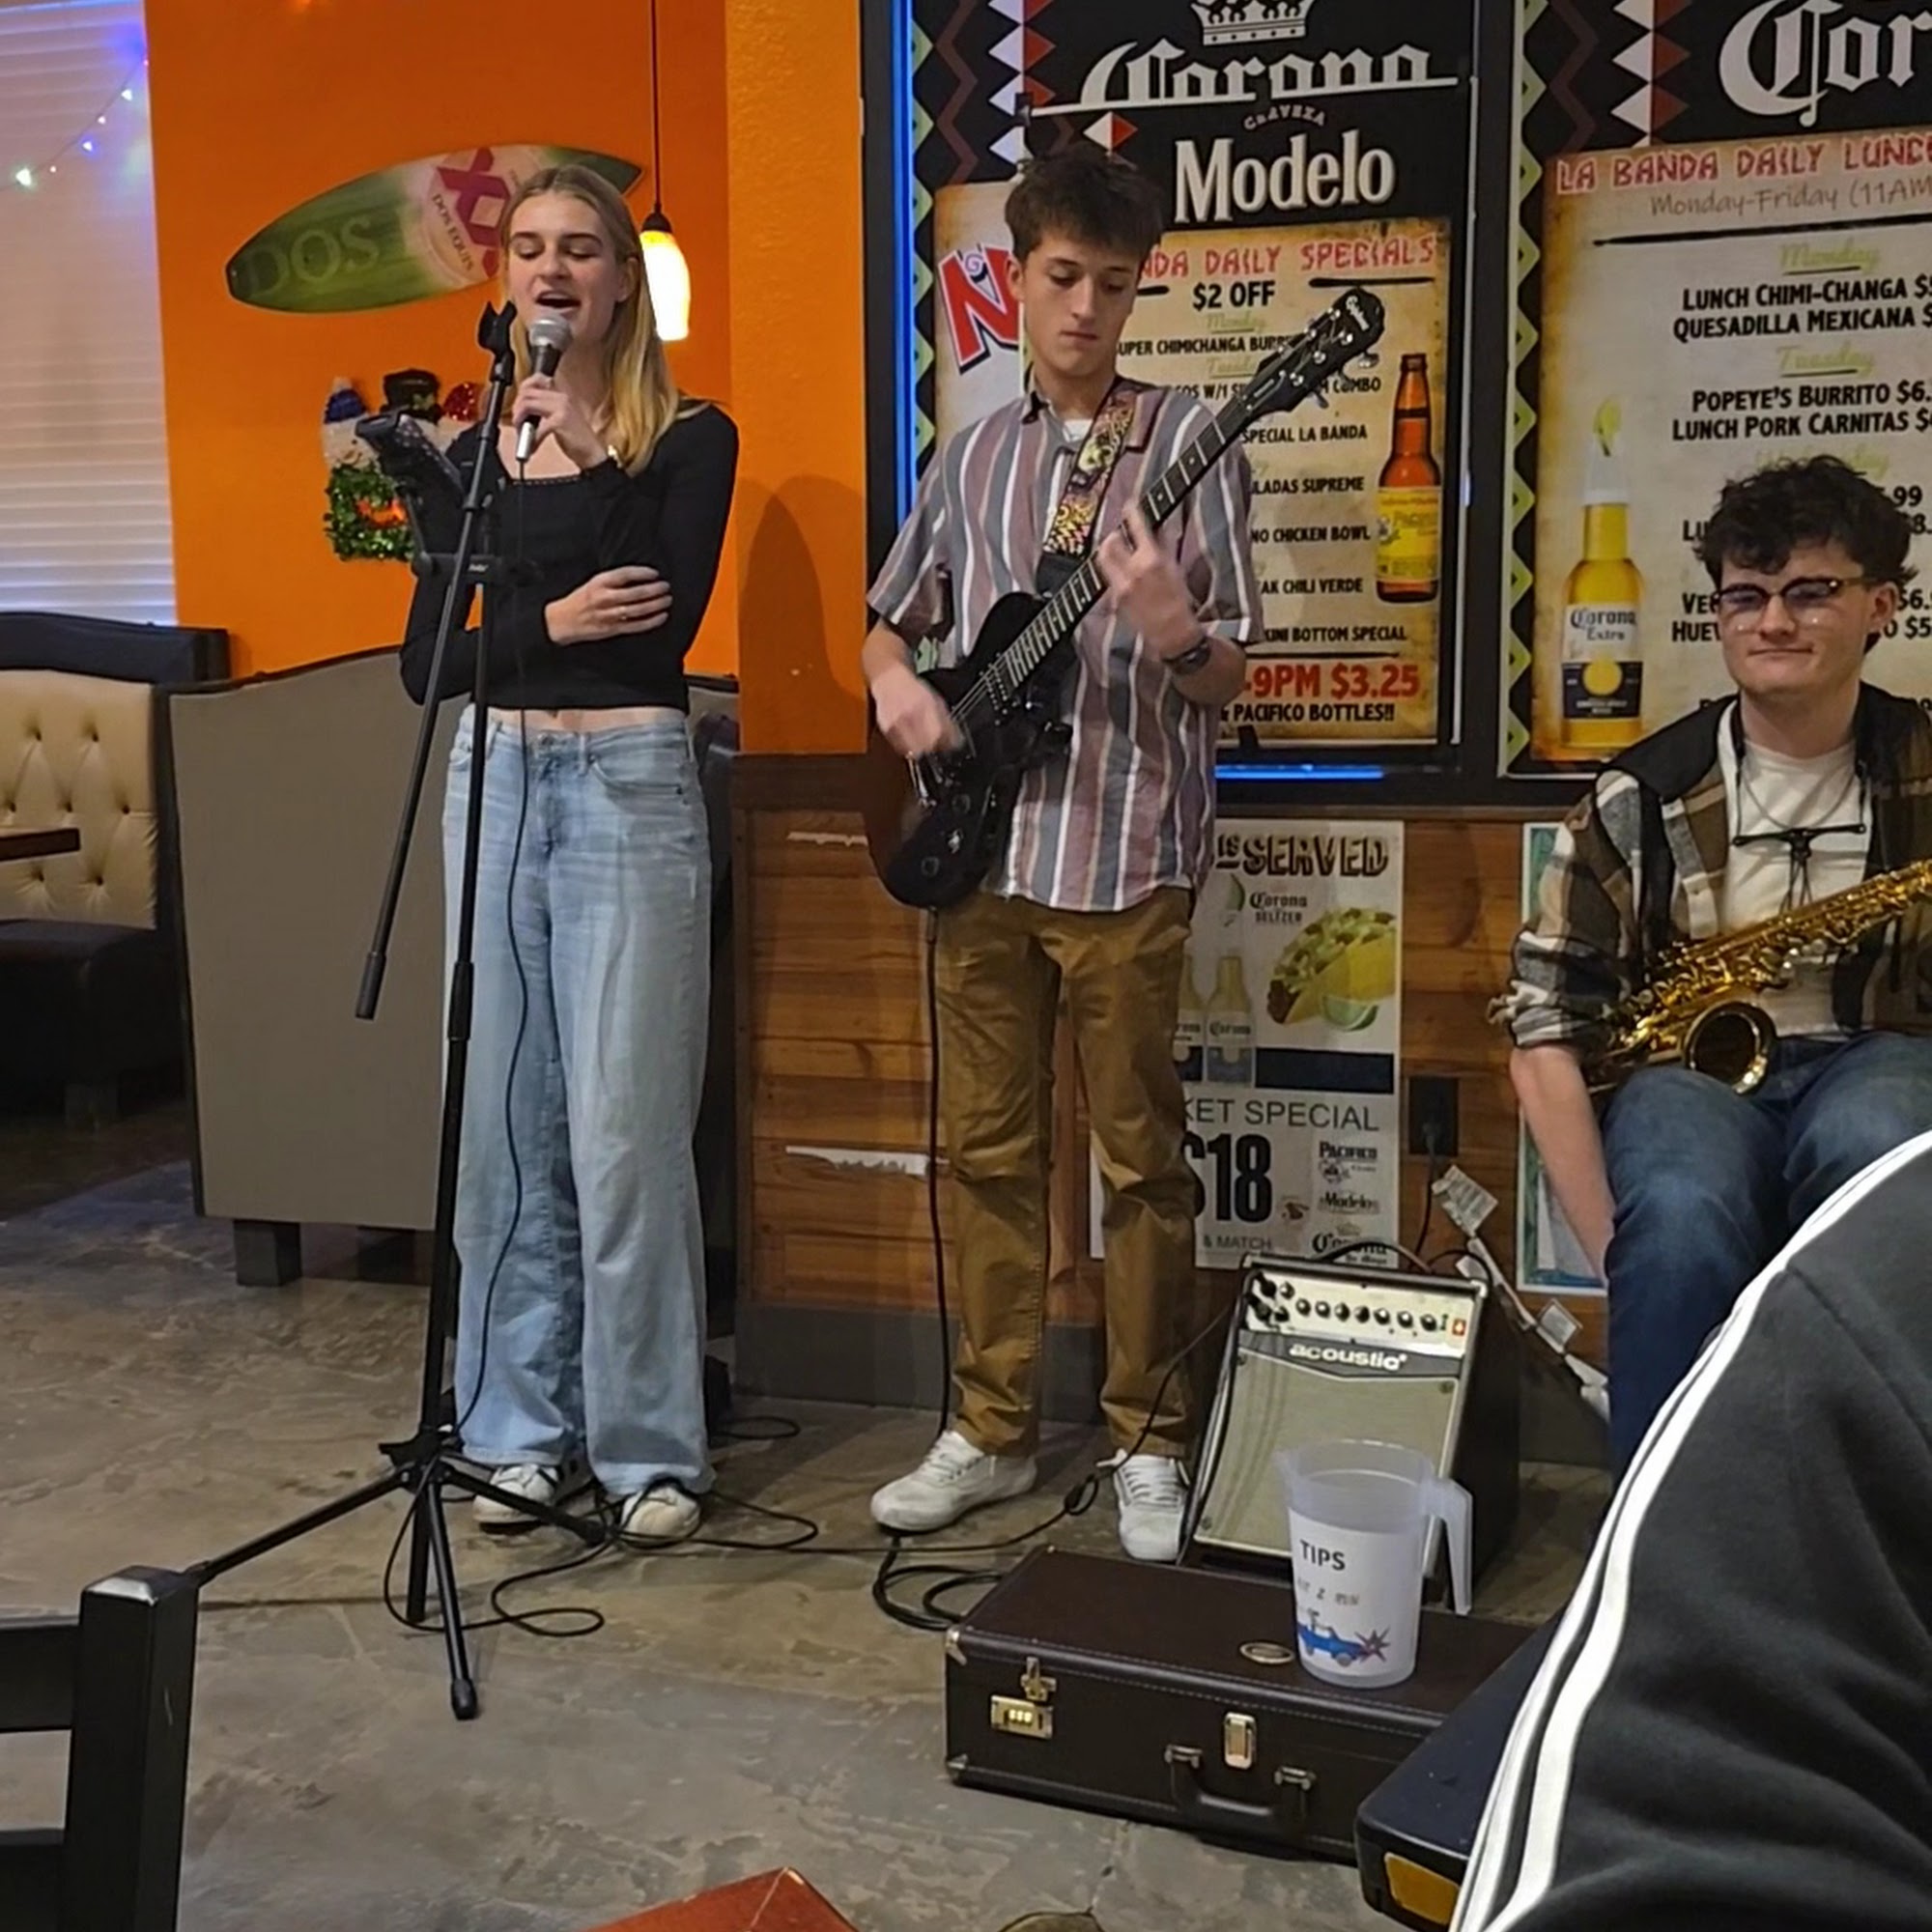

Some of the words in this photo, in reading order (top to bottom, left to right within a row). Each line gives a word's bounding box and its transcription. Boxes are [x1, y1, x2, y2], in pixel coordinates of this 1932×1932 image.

[1063, 38, 1458, 109] Corona
[1174, 129, 1396, 224] Modelo
[1557, 157, 1597, 192] LA
[1612, 149, 1719, 187] BANDA
[1736, 143, 1825, 177] DAILY
[1651, 186, 1837, 215] Monday-Friday
[242, 218, 383, 297] DOS
[1204, 245, 1281, 275] DAILY
[1299, 235, 1435, 271] SPECIALS
[1192, 281, 1222, 311] $2
[1230, 280, 1276, 307] OFF
[1683, 287, 1748, 311] LUNCH
[1755, 277, 1907, 307] CHIMI-CHANGA
[1674, 313, 1800, 343] QUESADILLA
[1806, 306, 1916, 333] MEXICANA
[1118, 341, 1153, 357] UPER
[1156, 337, 1246, 355] CHIMICHANGA
[1692, 385, 1792, 412] POPEYE'S
[1798, 383, 1890, 409] BURRITO
[1241, 428, 1295, 444] SPECIAL
[1298, 428, 1317, 442] LA
[1321, 424, 1368, 440] BANDA
[1672, 419, 1739, 441] LUNCH
[1745, 414, 1801, 438] PORK
[1808, 410, 1910, 434] CARNITAS
[1253, 478, 1299, 496] LADAS
[1302, 476, 1365, 494] SUPREME
[1273, 526, 1326, 543] CHICKEN
[1330, 525, 1371, 542] BOWL
[1320, 577, 1363, 593] VERDE
[1570, 608, 1638, 629] Corona
[1292, 627, 1350, 642] BOTTOM
[1351, 625, 1407, 641] SPECIAL
[1586, 628, 1626, 642] Extra
[1330, 662, 1420, 700] $3.25
[1234, 703, 1304, 723] PACIFICO
[1309, 702, 1394, 722] BOTTLES!!
[1242, 835, 1389, 877] SERVED
[1250, 890, 1308, 909] Corona
[1255, 911, 1303, 924] SELTZER
[1244, 1098, 1379, 1132] SPECIAL
[1216, 1235, 1273, 1251] MATCH
[1289, 1343, 1403, 1372] acoustic
[1299, 1538, 1347, 1572] TIPS
